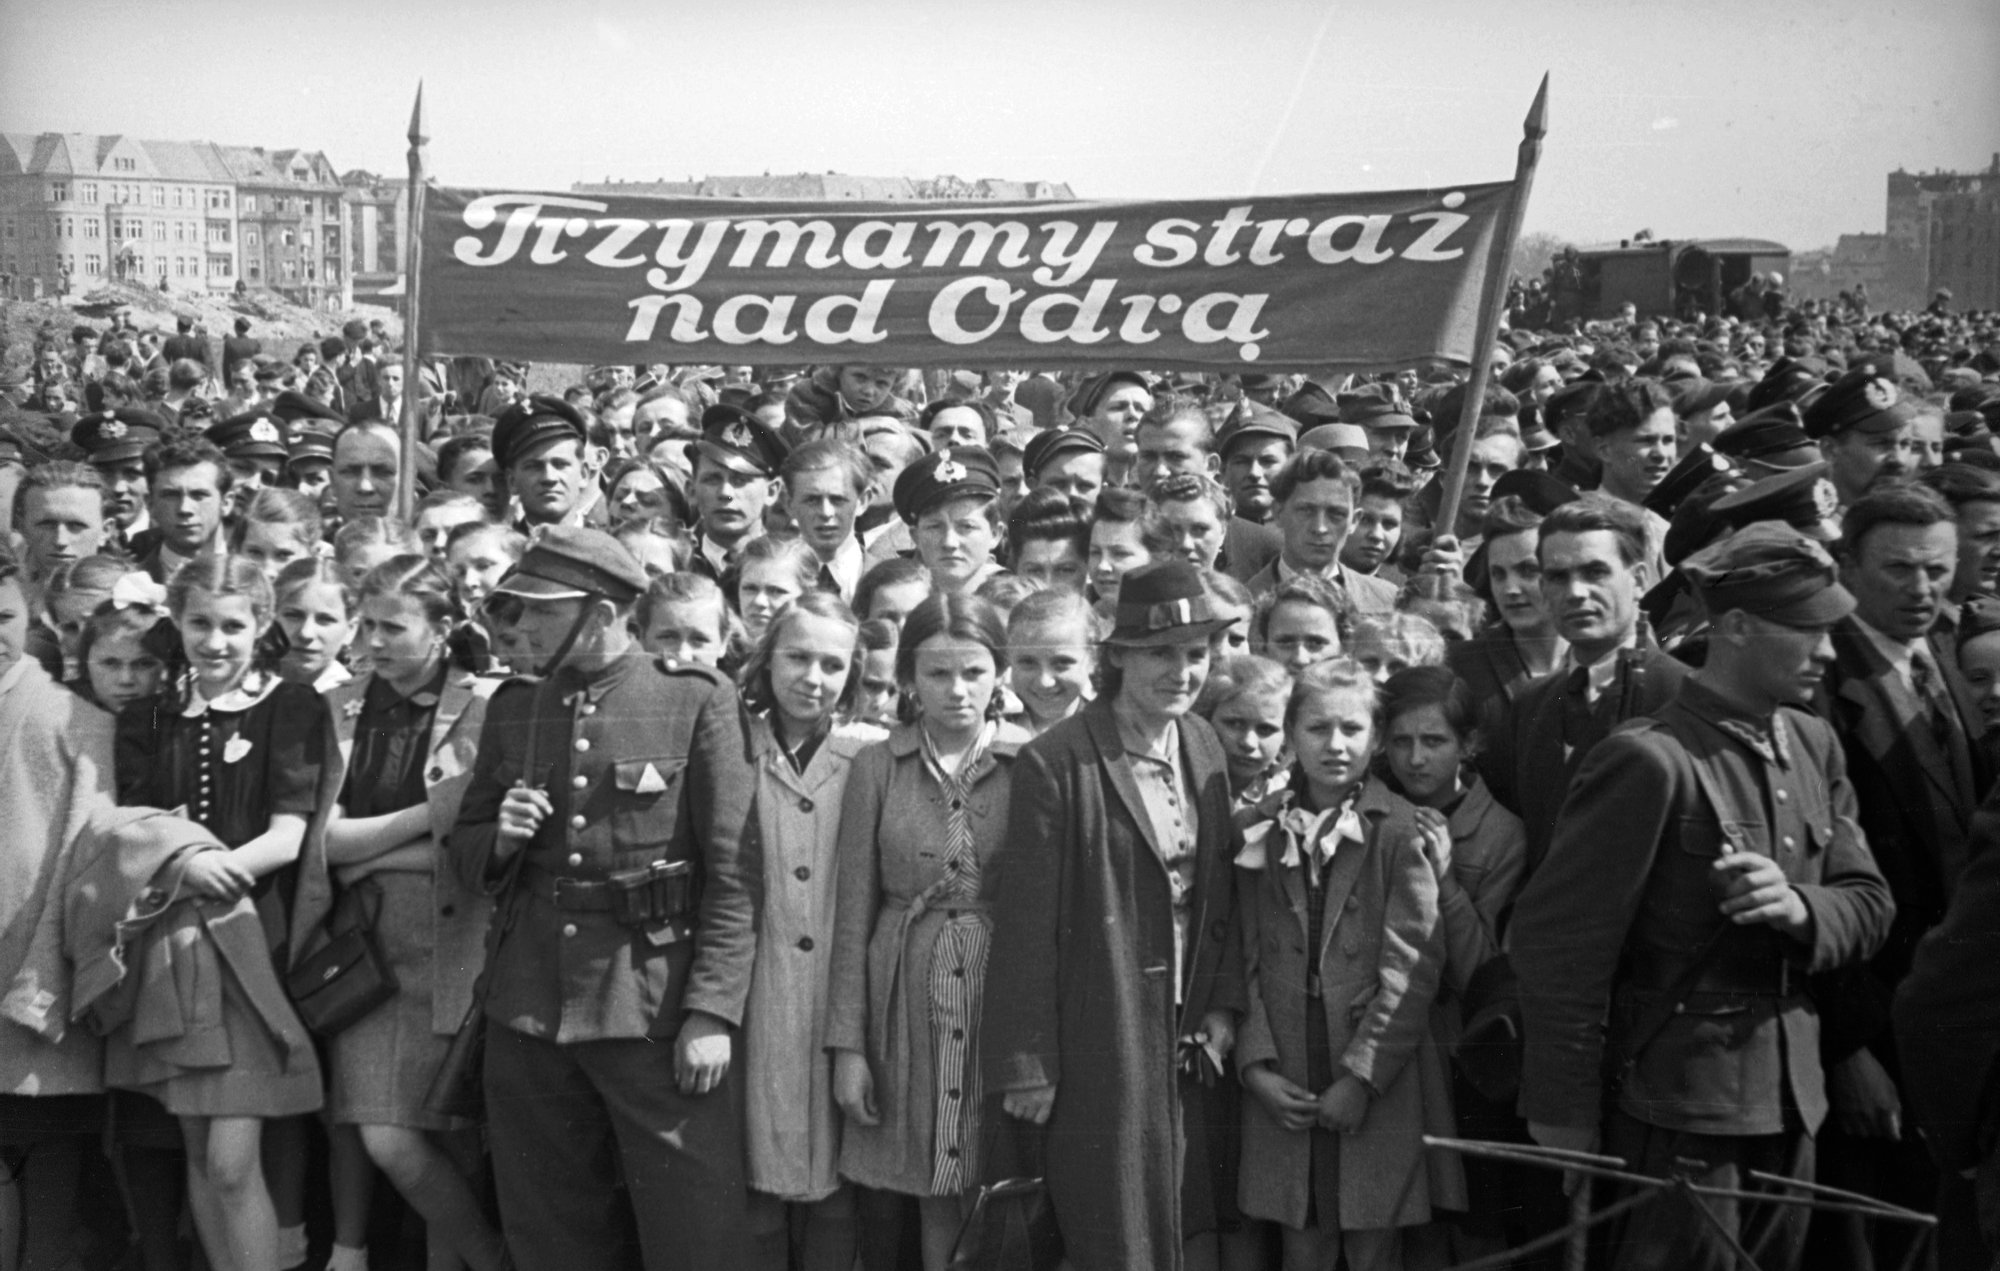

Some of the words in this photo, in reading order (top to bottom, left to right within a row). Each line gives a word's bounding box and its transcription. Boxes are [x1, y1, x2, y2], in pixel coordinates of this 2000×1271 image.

[453, 193, 1118, 291] Trzymamy
[1133, 191, 1470, 267] straż
[625, 279, 898, 345] nad
[928, 275, 1270, 362] Odrą
